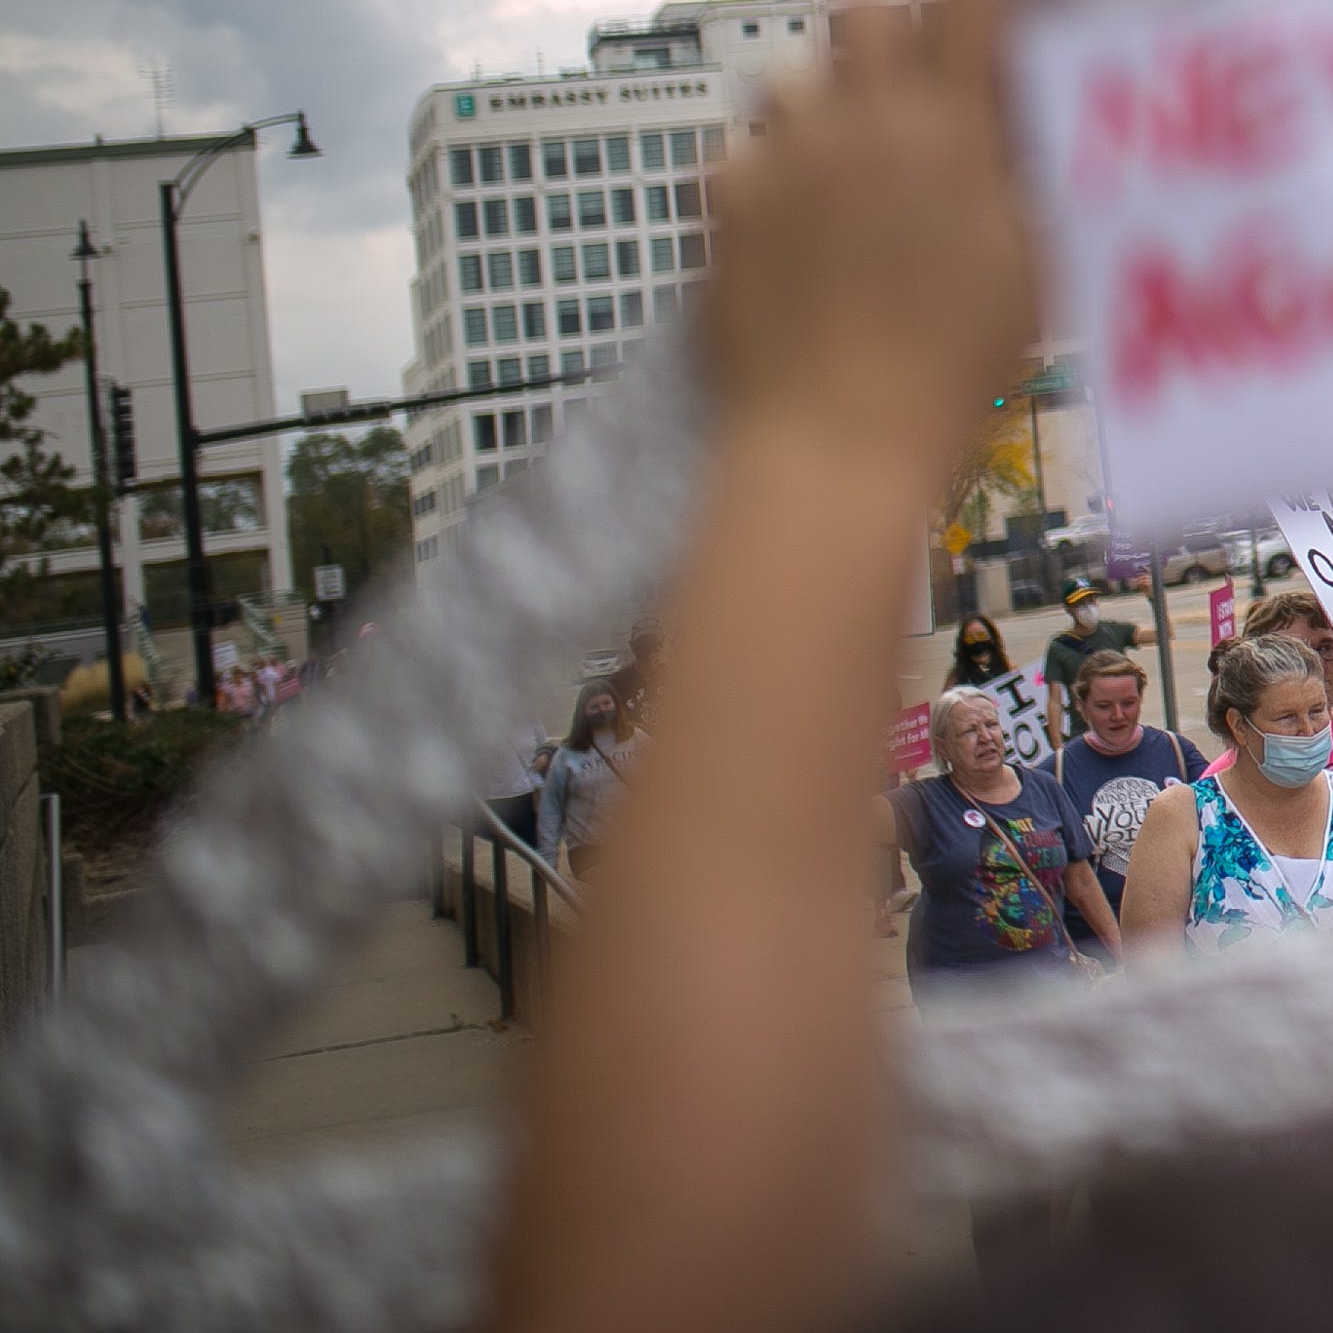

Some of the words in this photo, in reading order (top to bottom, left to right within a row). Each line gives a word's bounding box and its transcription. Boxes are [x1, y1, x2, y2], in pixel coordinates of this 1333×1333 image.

[490, 86, 608, 112] EMBASSY
[619, 79, 708, 102] SUITES
[1282, 492, 1321, 512] WE
[1085, 818, 1138, 845] VOI
[1096, 804, 1147, 833] YOU
